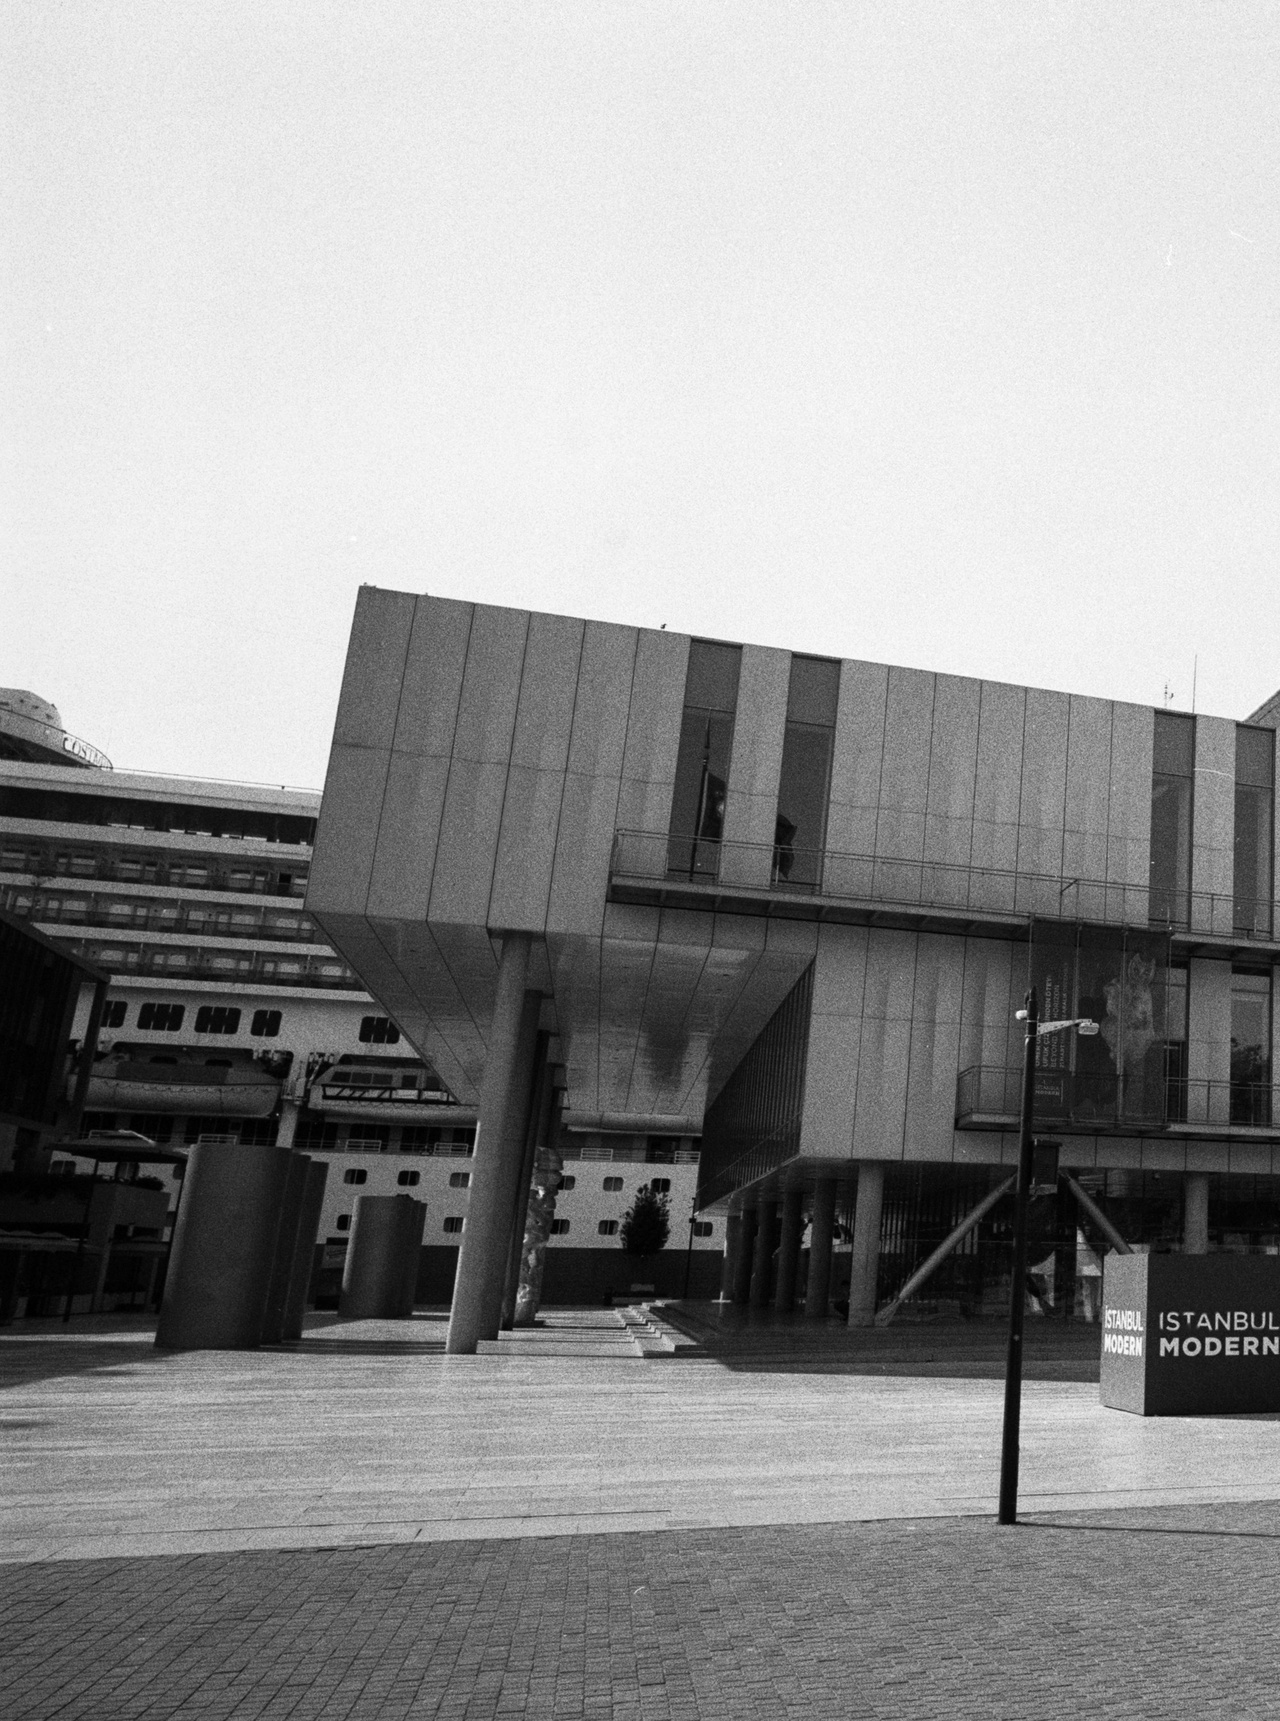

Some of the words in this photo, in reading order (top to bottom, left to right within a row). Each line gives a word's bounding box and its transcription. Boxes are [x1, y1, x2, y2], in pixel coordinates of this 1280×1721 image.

[1051, 1035, 1059, 1068] BEYOND
[1104, 1333, 1143, 1357] MODERN
[1158, 1336, 1280, 1357] MODERN
